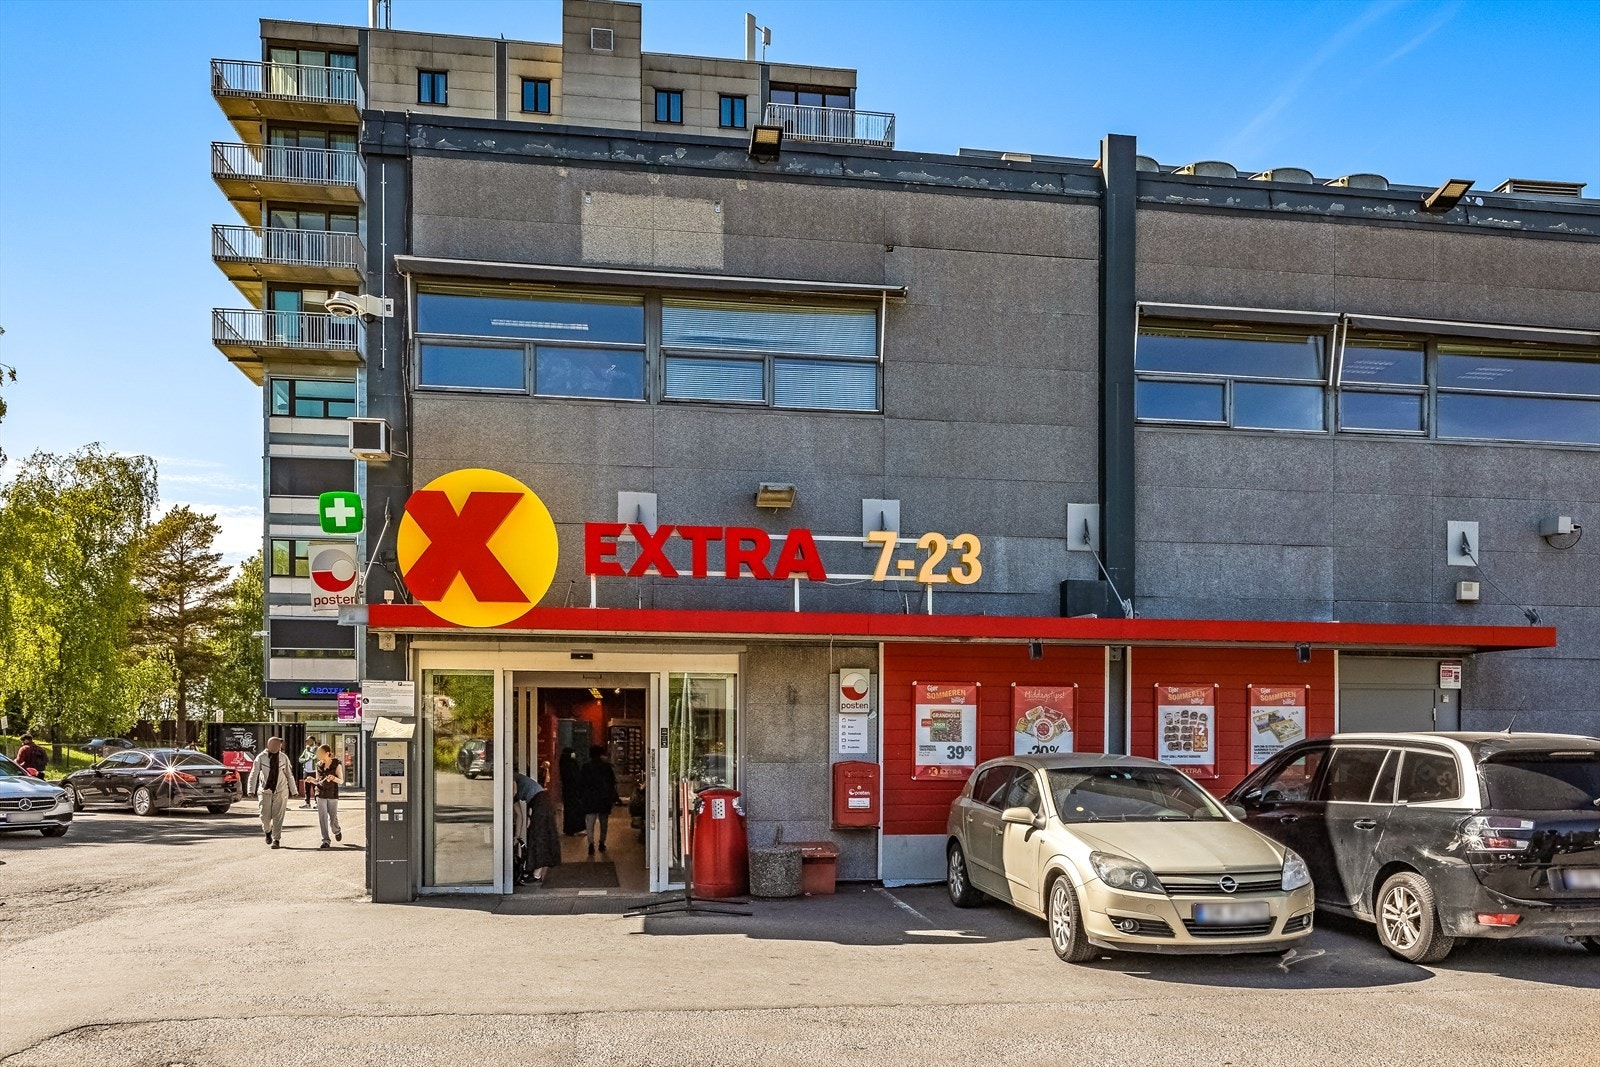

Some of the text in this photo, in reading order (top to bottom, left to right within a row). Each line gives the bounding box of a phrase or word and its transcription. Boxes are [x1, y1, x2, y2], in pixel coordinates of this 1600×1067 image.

[584, 522, 983, 586] EXTRA 7-23
[309, 687, 345, 695] APOTEK
[926, 689, 967, 699] SOMMEREN
[1167, 690, 1206, 701] SOMMEREN
[1260, 691, 1297, 701] SOMMEREN
[841, 702, 869, 710] posten
[946, 745, 965, 760] 39
[940, 768, 963, 776] EXTRA
